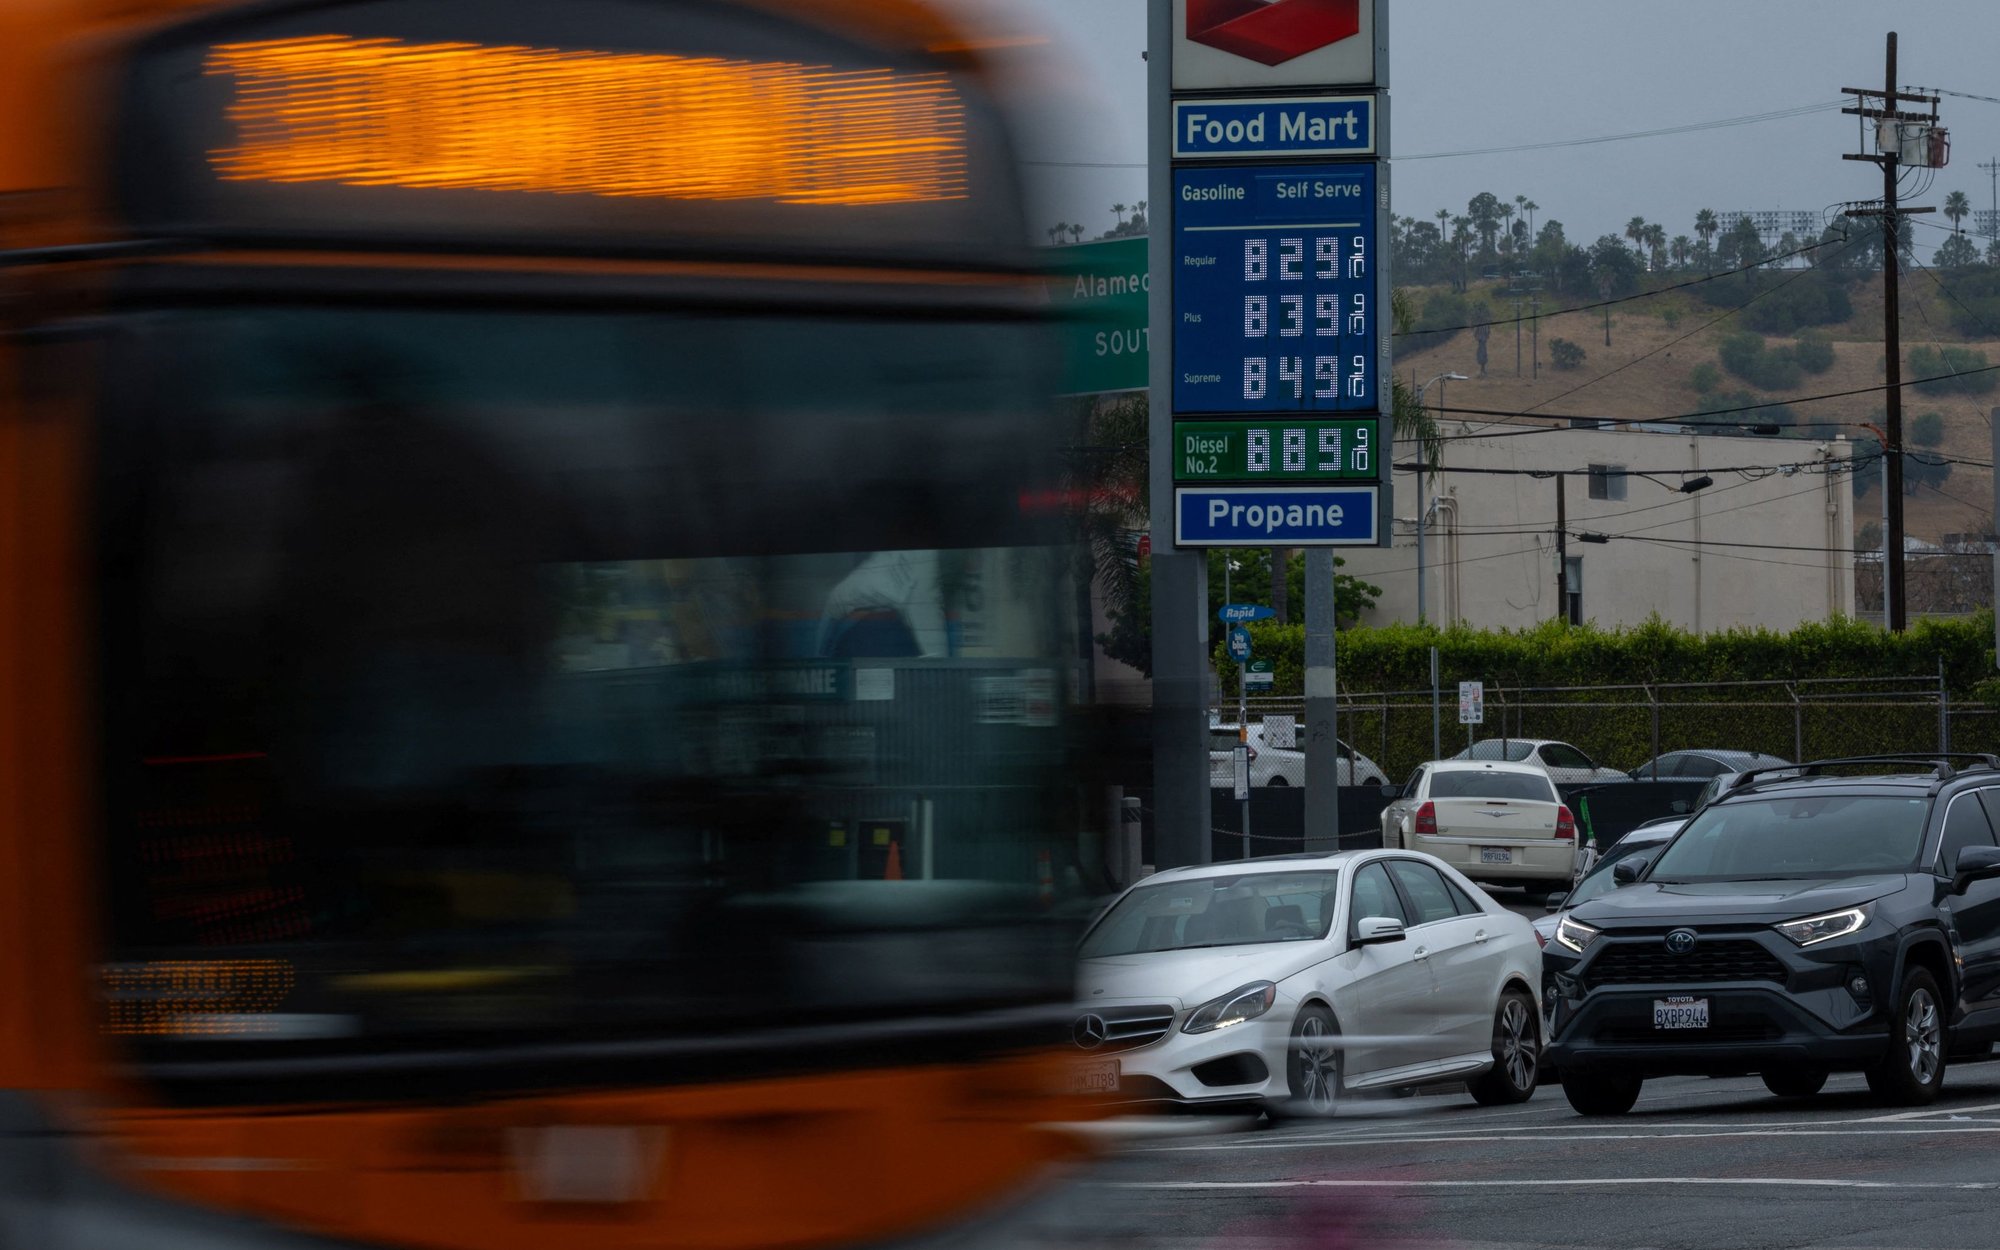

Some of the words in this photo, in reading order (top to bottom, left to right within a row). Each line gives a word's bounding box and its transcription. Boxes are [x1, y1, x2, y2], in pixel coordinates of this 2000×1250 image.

[1187, 111, 1265, 144] Food
[1279, 109, 1359, 143] Mart
[1182, 184, 1245, 201] Gasoline
[1276, 182, 1308, 199] Self
[1314, 181, 1361, 198] Serve
[1184, 255, 1217, 268] Regular
[1244, 236, 1339, 281] 829
[1184, 312, 1202, 323] Plus
[1244, 293, 1339, 338] 839
[1184, 373, 1221, 386] Supreme
[1243, 355, 1339, 400] 849
[1186, 436, 1229, 454] Diesel
[1247, 428, 1342, 472] 889
[1186, 456, 1218, 474] No.2
[1208, 499, 1344, 534] Propane
[1226, 607, 1256, 620] Rapid
[1656, 1008, 1707, 1024] 8XBP944
